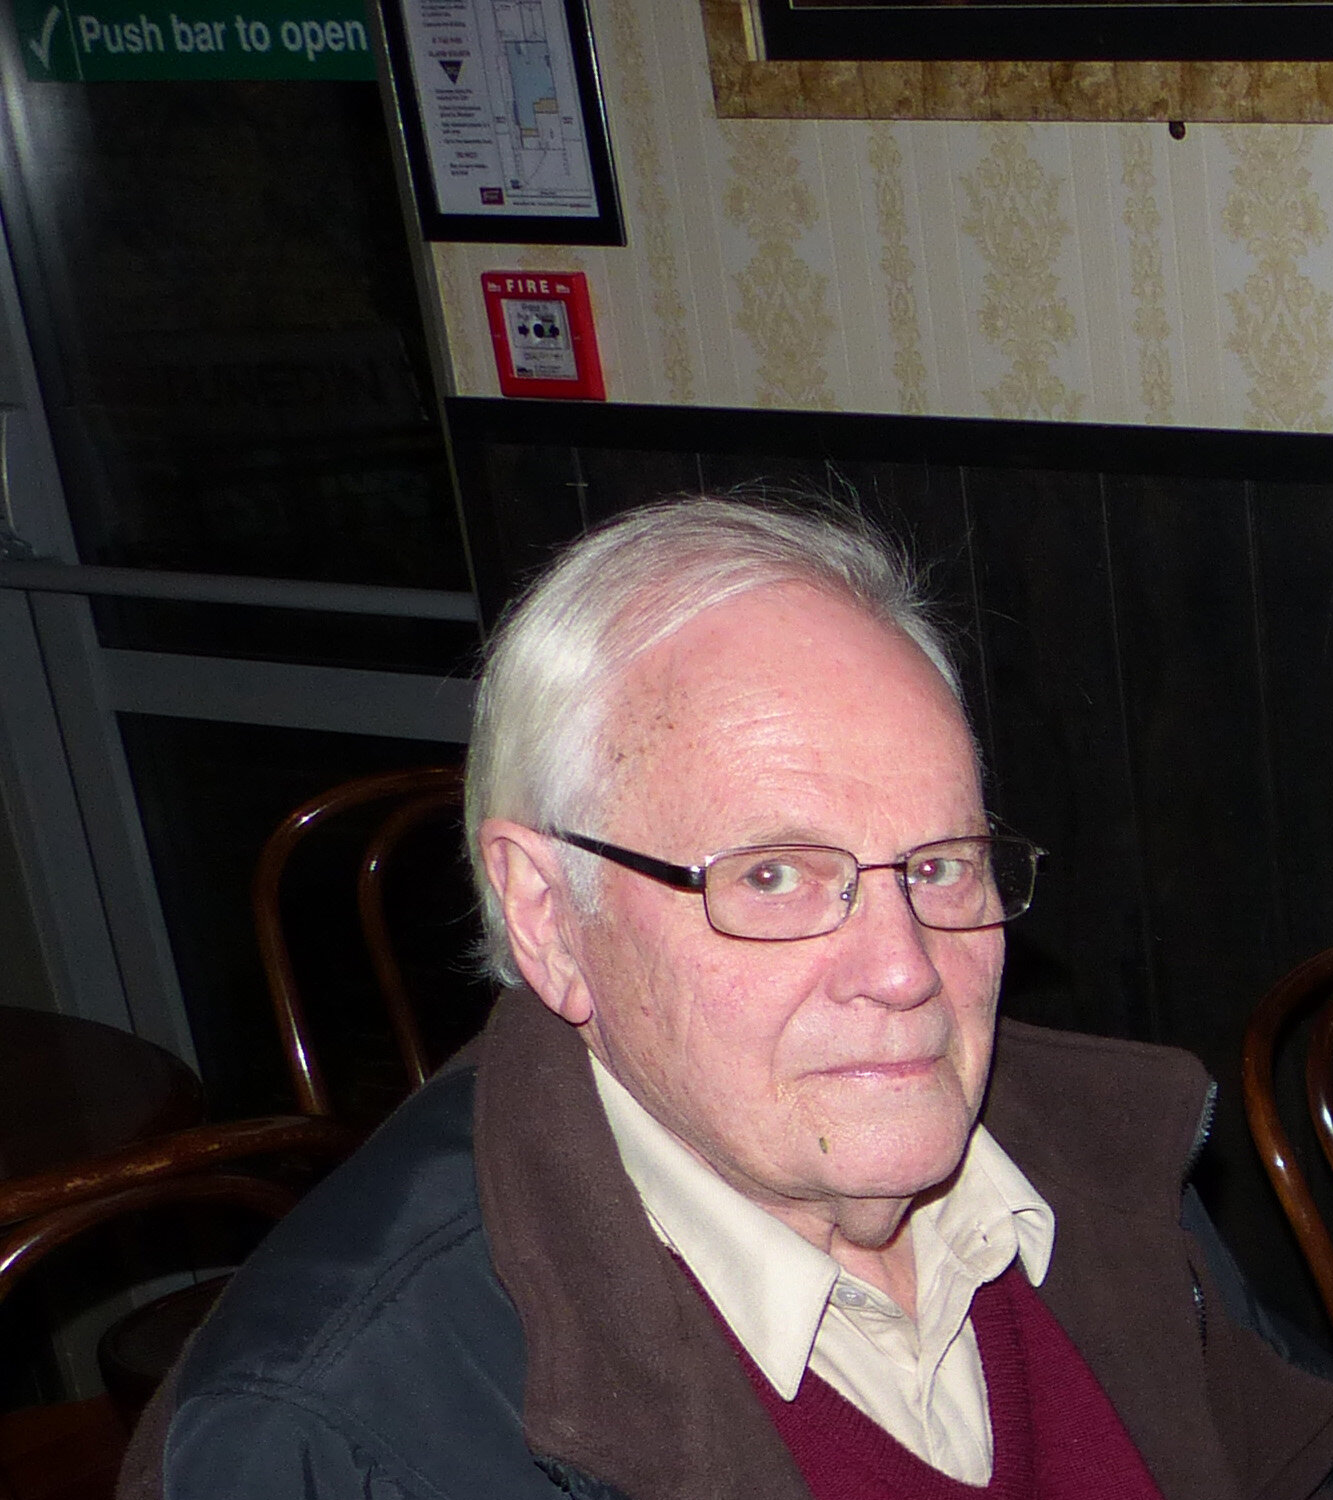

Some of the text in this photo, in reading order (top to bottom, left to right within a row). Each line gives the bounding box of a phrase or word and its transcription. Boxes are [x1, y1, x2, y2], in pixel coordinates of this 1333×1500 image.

[78, 13, 368, 62] Push bar to open
[505, 278, 551, 294] FIRE
